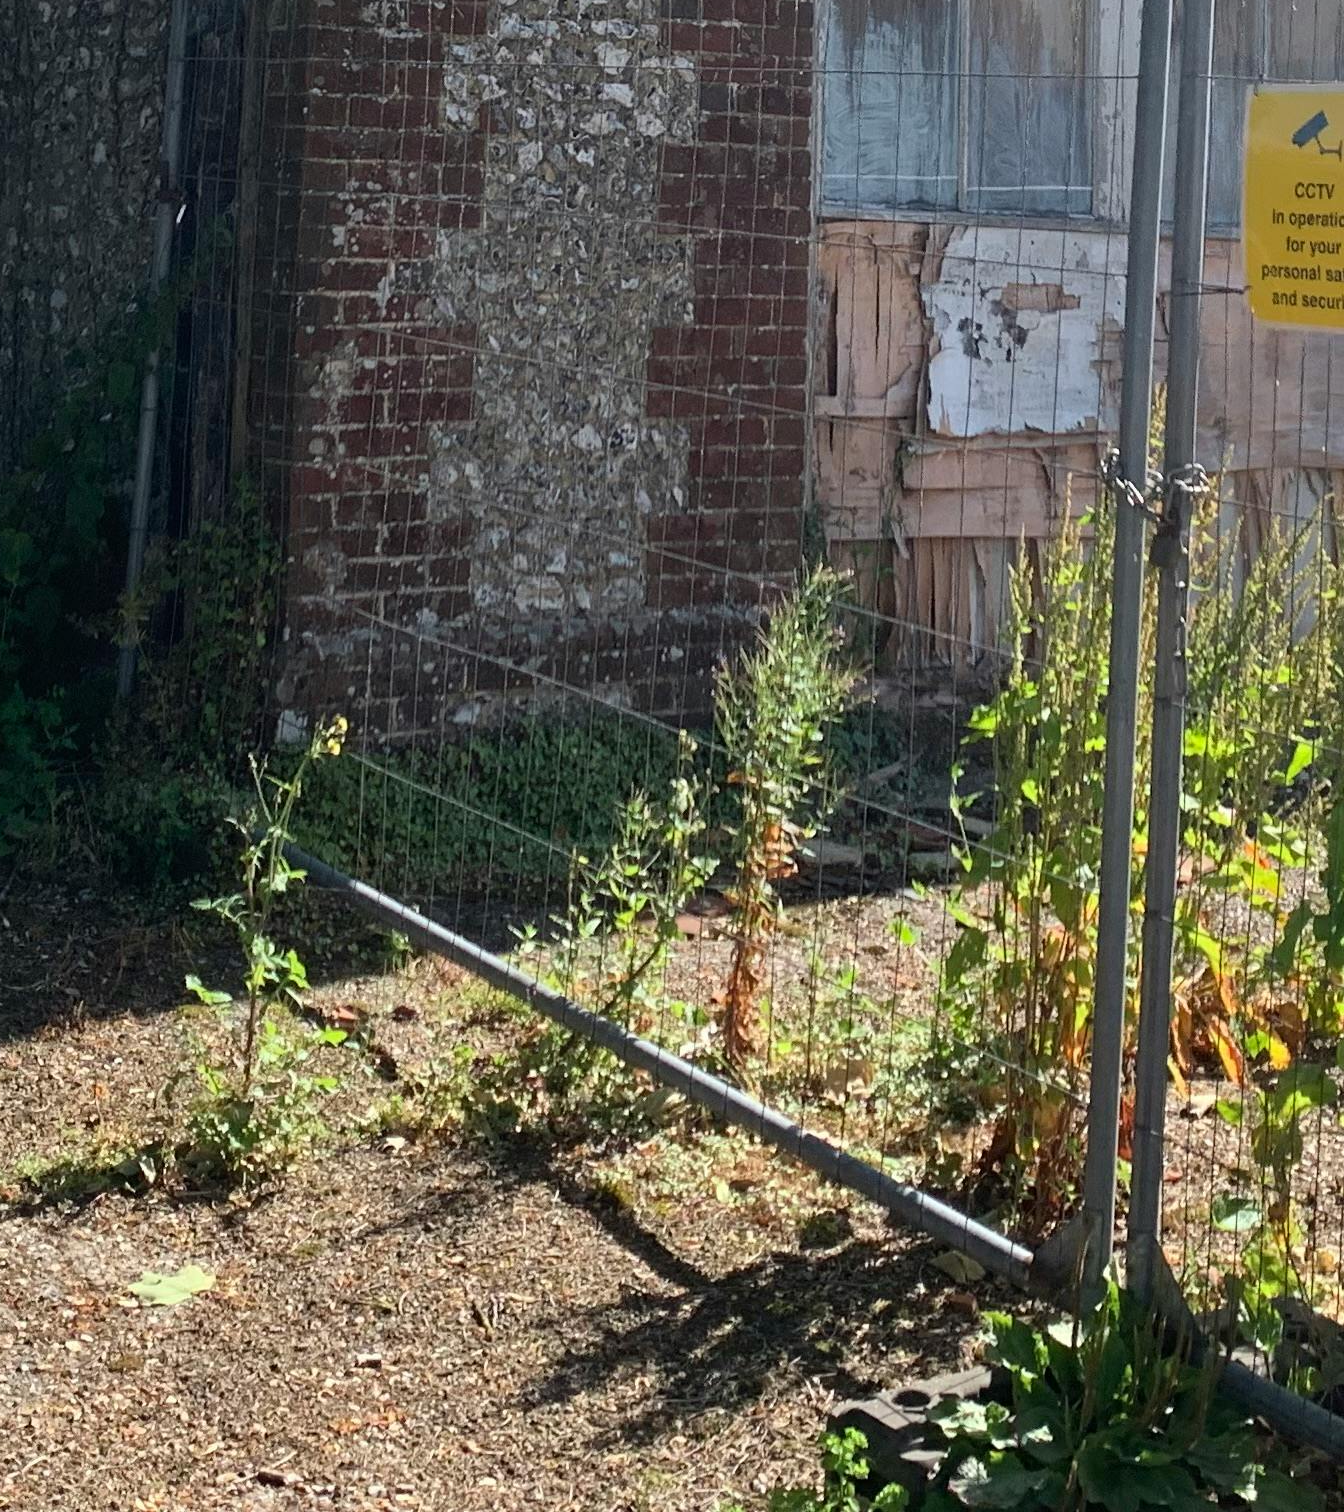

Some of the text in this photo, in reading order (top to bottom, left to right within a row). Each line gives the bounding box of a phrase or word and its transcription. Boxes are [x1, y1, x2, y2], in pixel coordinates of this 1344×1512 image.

[1294, 181, 1335, 200] CCTV
[1286, 236, 1342, 257] for your
[1261, 264, 1321, 281] personal
[1272, 290, 1297, 307] and
